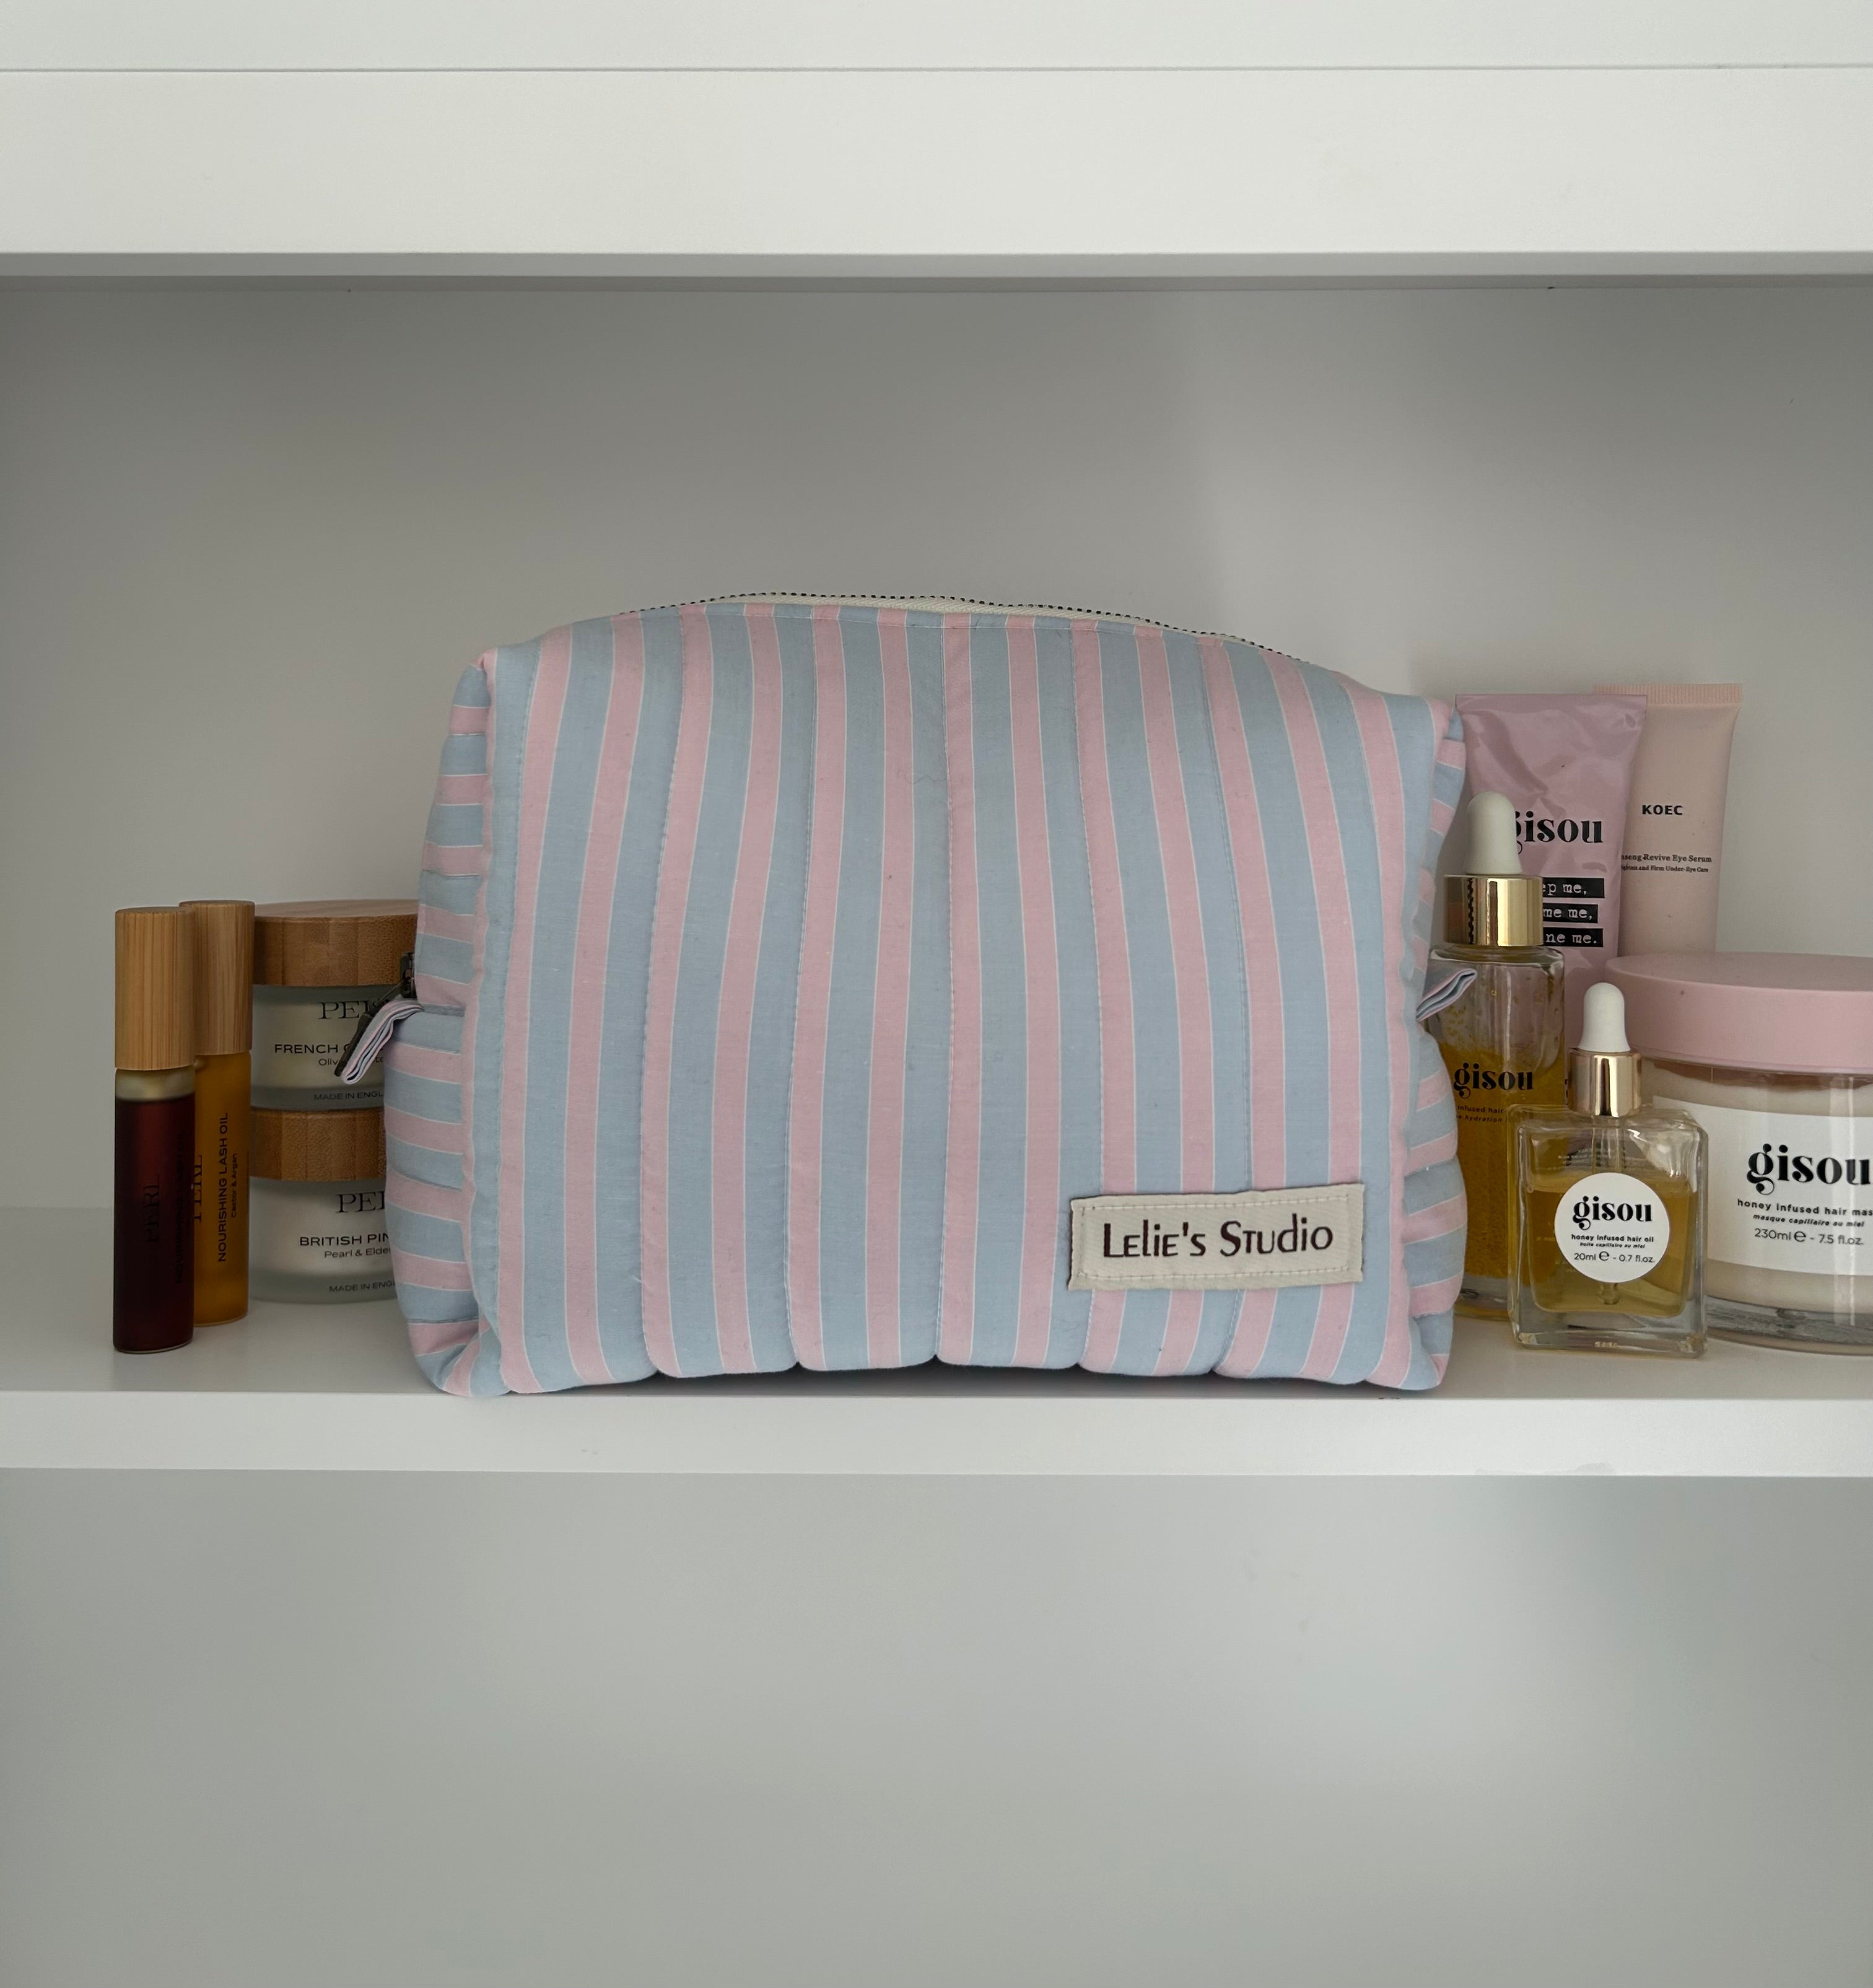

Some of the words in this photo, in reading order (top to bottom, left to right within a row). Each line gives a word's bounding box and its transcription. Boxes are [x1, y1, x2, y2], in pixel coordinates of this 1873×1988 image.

[1642, 805, 1683, 815] KOEC
[1515, 811, 1603, 855] isou
[1672, 854, 1687, 863] Eye
[1563, 884, 1587, 895] me,
[1568, 909, 1592, 920] me,
[1572, 934, 1597, 944] me.
[274, 1044, 339, 1054] FRENCH
[1453, 1062, 1534, 1099] gisou
[219, 1113, 229, 1134] OIL
[219, 1138, 228, 1175] LASH
[1747, 1143, 1871, 1196] gisou
[1572, 1196, 1653, 1230] gisou
[1737, 1199, 1771, 1211] honey
[1776, 1203, 1819, 1214] infused
[1824, 1207, 1847, 1215] hair
[218, 1178, 228, 1262] NOURISHING
[1753, 1214, 1785, 1222] masque
[1788, 1217, 1830, 1228] capillaire
[300, 1235, 362, 1246] BRITISH
[1754, 1228, 1791, 1241] 230ml
[1818, 1233, 1834, 1244] 7.5
[325, 1250, 352, 1258] Pearl
[1574, 1253, 1596, 1261] 20ml
[1618, 1254, 1633, 1262] 0.7
[329, 1284, 358, 1292] MADE
